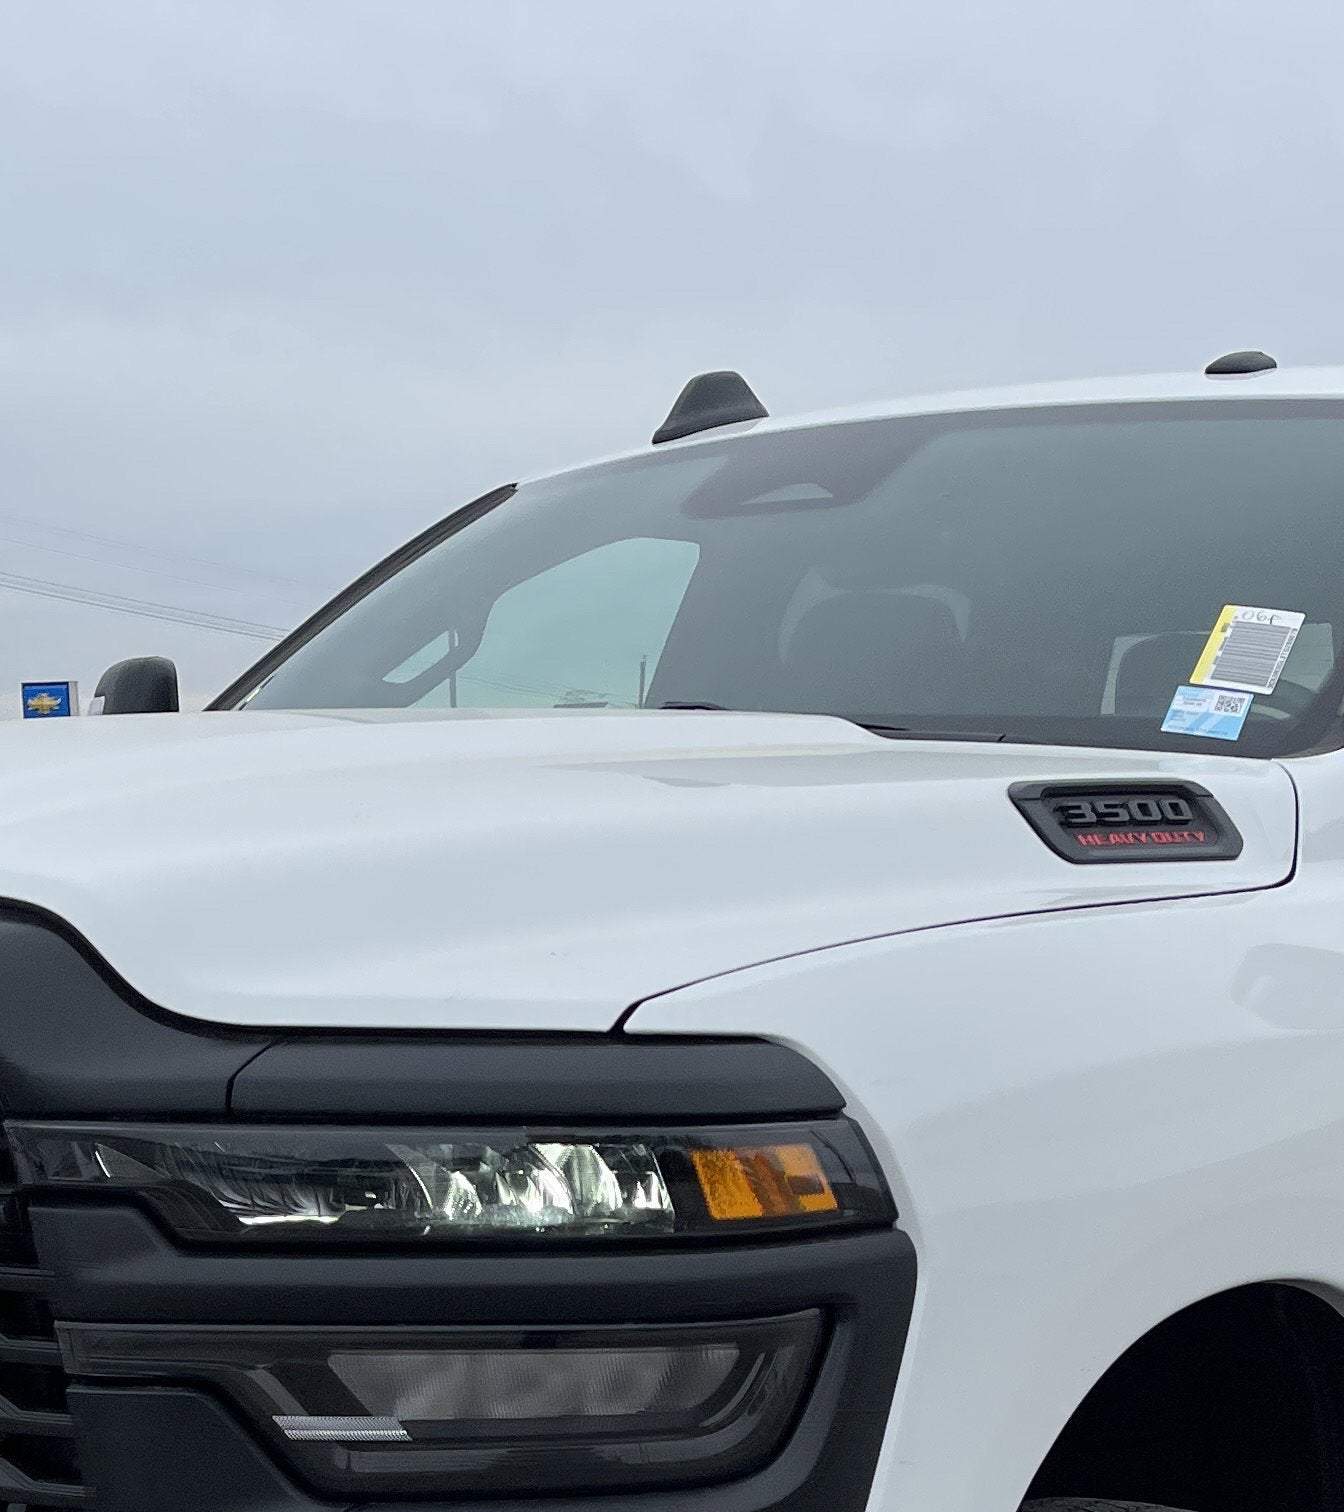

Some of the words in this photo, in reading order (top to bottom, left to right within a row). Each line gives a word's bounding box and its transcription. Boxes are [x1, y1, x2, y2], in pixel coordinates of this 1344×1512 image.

[1057, 799, 1193, 825] 3500
[1076, 832, 1147, 846] HEAVY
[1149, 831, 1205, 844] DUTY
